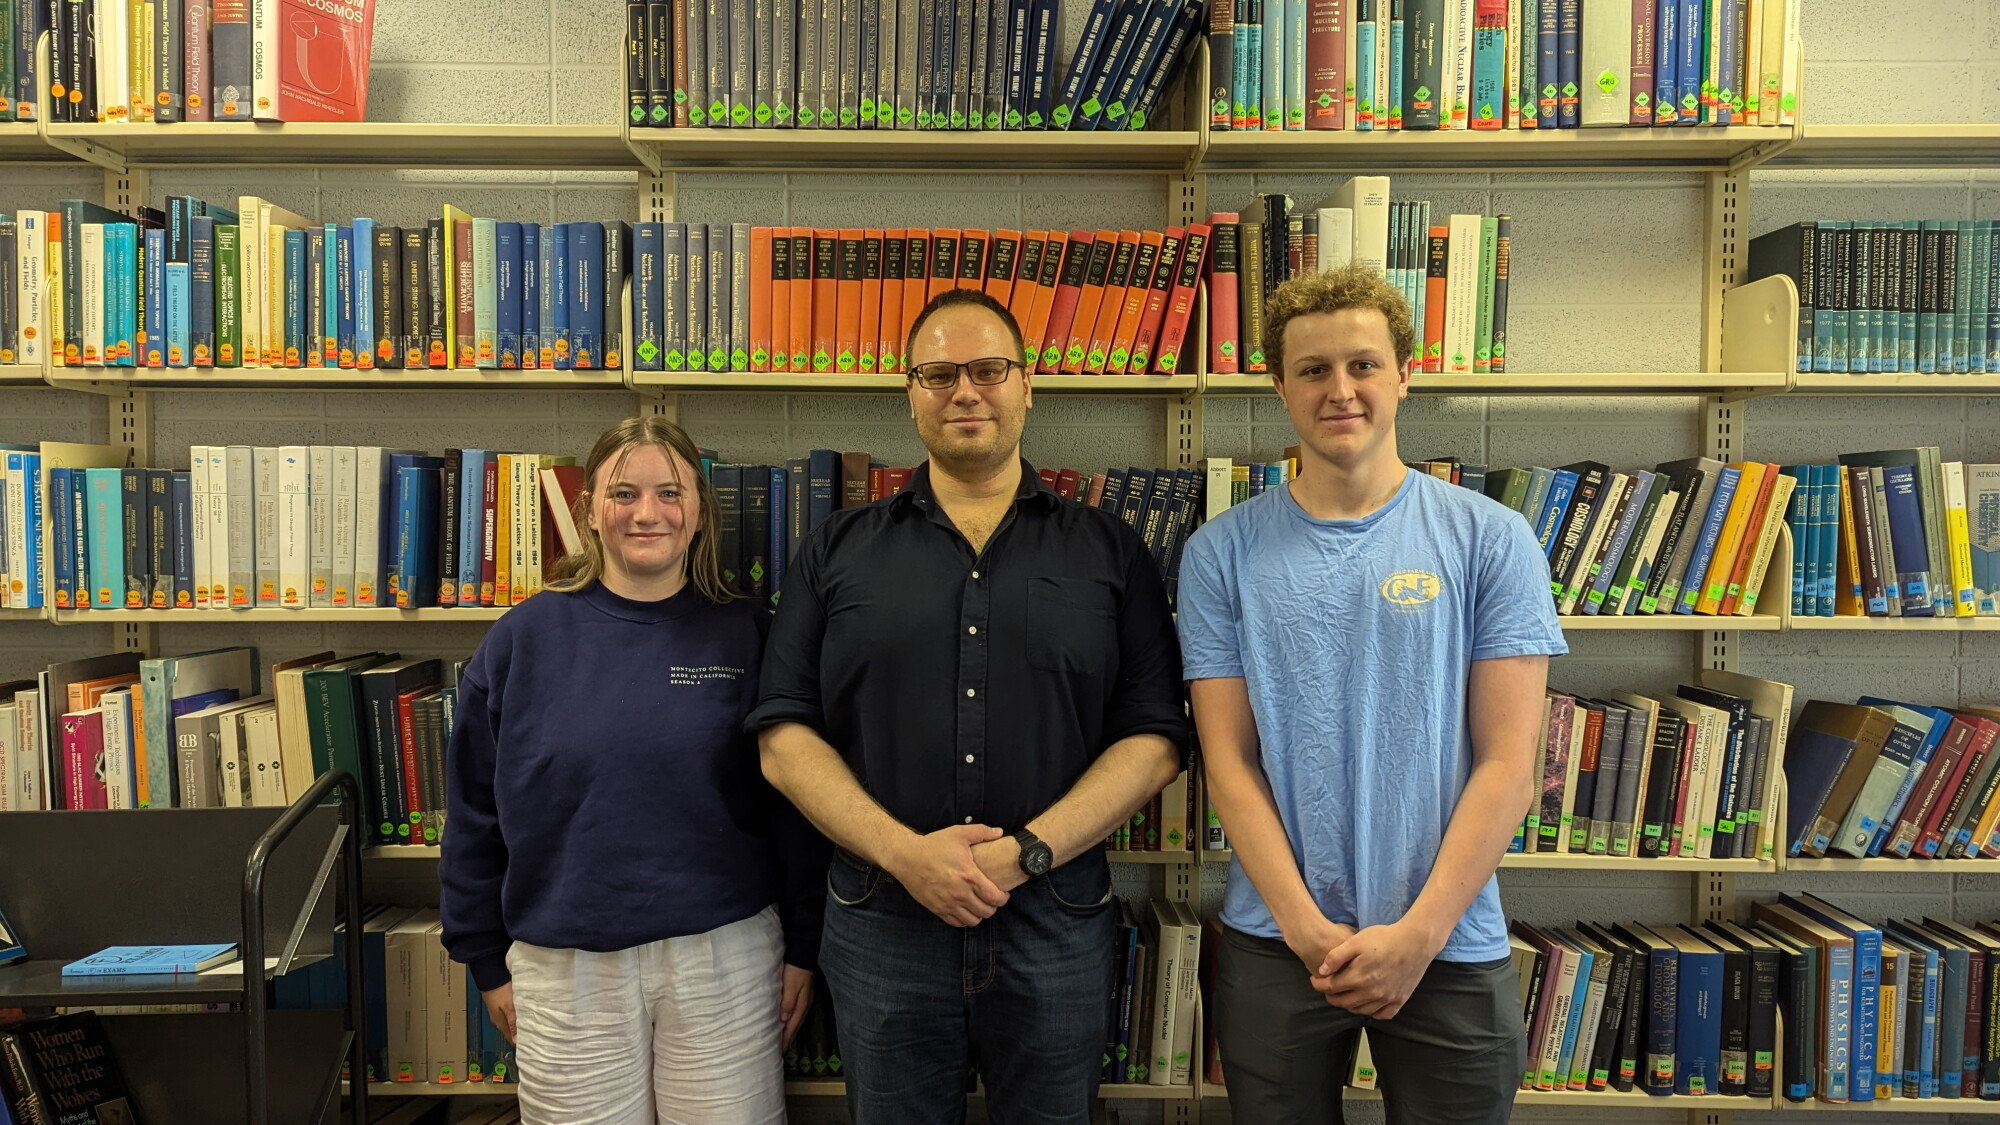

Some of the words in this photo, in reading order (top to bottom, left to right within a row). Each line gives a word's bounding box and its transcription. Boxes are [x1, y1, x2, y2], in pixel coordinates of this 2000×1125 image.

[307, 0, 364, 23] COSMOS
[1496, 13, 1504, 36] High
[1479, 16, 1487, 50] Physics
[1488, 13, 1496, 47] Energy
[255, 41, 263, 80] COSMOS
[1458, 45, 1468, 82] NUCLEAR
[281, 90, 294, 100] JOHN
[294, 92, 322, 109] ARCHIBALD
[321, 102, 344, 115] WHEELER
[1818, 233, 1826, 278] MOLECULAR
[668, 356, 682, 364] ANS
[815, 356, 828, 364] ARN
[1044, 353, 1058, 361] ARN
[35, 520, 42, 534] IN
[1539, 506, 1561, 549] Cosmology
[1564, 502, 1591, 549] COSMOLOGY
[1620, 502, 1638, 537] MODERN
[484, 508, 494, 561] SUPERGRAVITY
[1600, 536, 1624, 584] COSMOLOGY
[708, 666, 745, 674] COLLECTIVE
[1696, 716, 1706, 745] DISTANCE
[1700, 728, 1712, 776] COSMOLOGICAL
[1892, 739, 1912, 750] OPTICS
[1692, 747, 1702, 772] LADDER
[1938, 758, 1950, 780] ATOMIC
[1970, 754, 1983, 774] WAVES
[1964, 776, 1972, 784] IN
[1924, 780, 1940, 808] COLLISION
[1952, 784, 1967, 811] LAYERED
[1164, 958, 1174, 983] Theory
[1886, 962, 1895, 970] 15
[1612, 962, 1624, 998] UNIVERSE
[1654, 963, 1662, 1017] TOPOLOGY
[1669, 959, 1678, 1019] RELATIVITY
[1163, 990, 1171, 1018] Complex
[1837, 978, 1848, 1071] PHYSICS
[1864, 986, 1875, 1060] PHYSICS
[29, 1027, 86, 1050] Women
[36, 1049, 74, 1070] Who
[75, 1044, 106, 1062] Run
[43, 1068, 80, 1092] With
[82, 1065, 106, 1082] the
[51, 1086, 102, 1111] Wolves
[60, 1112, 78, 1125] Myths
[78, 1110, 90, 1120] and
